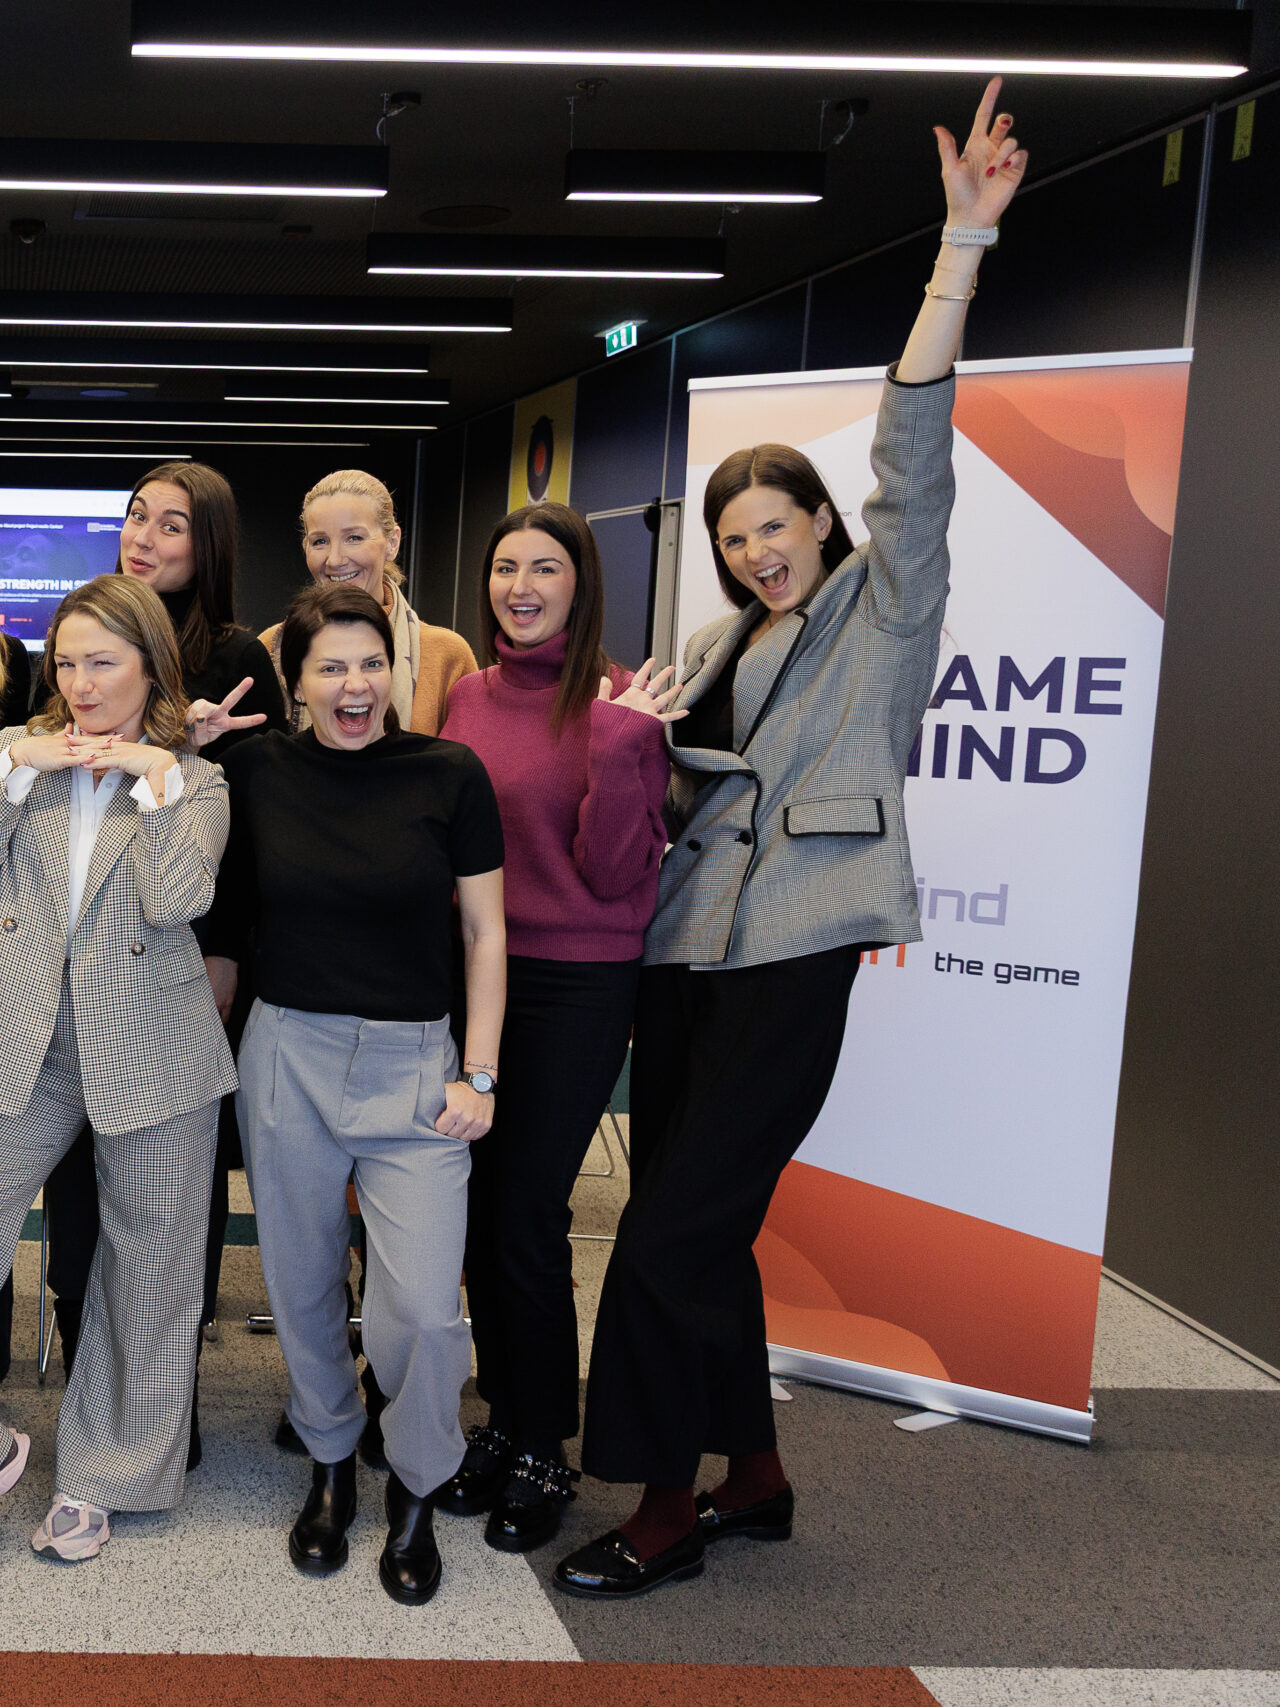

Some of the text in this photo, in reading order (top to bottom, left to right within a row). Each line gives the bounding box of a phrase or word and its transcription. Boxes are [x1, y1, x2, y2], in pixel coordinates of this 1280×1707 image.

[60, 579, 73, 591] IN
[926, 654, 1127, 716] AME
[916, 877, 1009, 926] ind
[934, 951, 984, 976] the
[993, 962, 1081, 987] game
